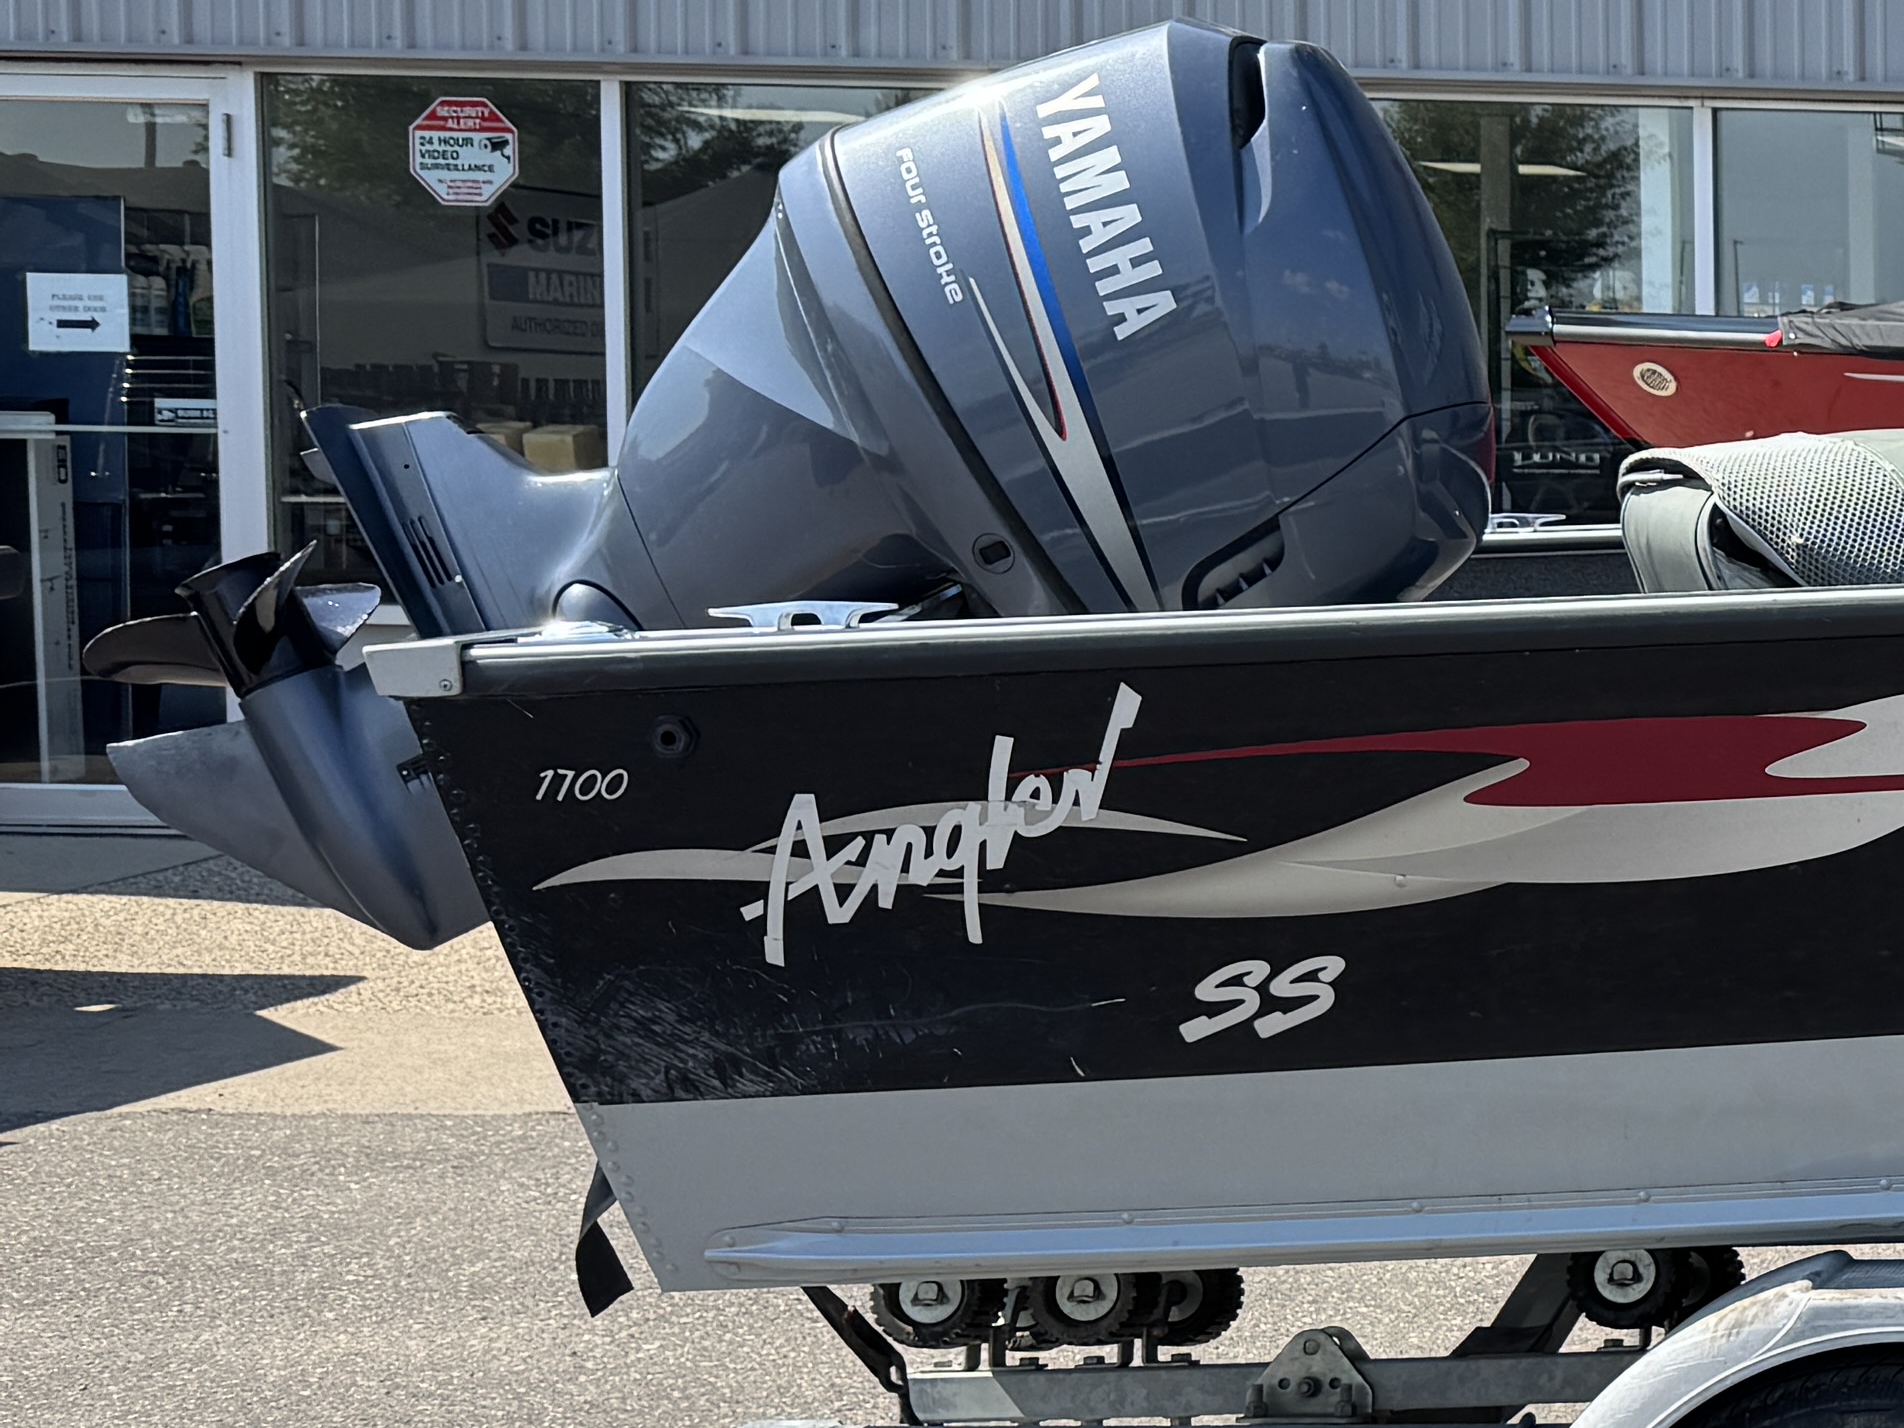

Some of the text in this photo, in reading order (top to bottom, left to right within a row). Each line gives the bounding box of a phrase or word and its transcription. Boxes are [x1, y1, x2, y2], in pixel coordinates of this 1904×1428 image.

[446, 118, 482, 130] ALERT
[418, 136, 475, 148] 24 HOUR
[418, 149, 460, 161] VIDEO
[418, 162, 496, 174] SURVEILLANCE
[1035, 72, 1178, 341] YAMAHA
[527, 215, 598, 257] SUZ
[528, 270, 602, 304] MARIN
[1512, 450, 1600, 467] LUND
[535, 767, 629, 803] 1700
[740, 680, 1142, 967] Angler
[1177, 955, 1346, 1044] SS
